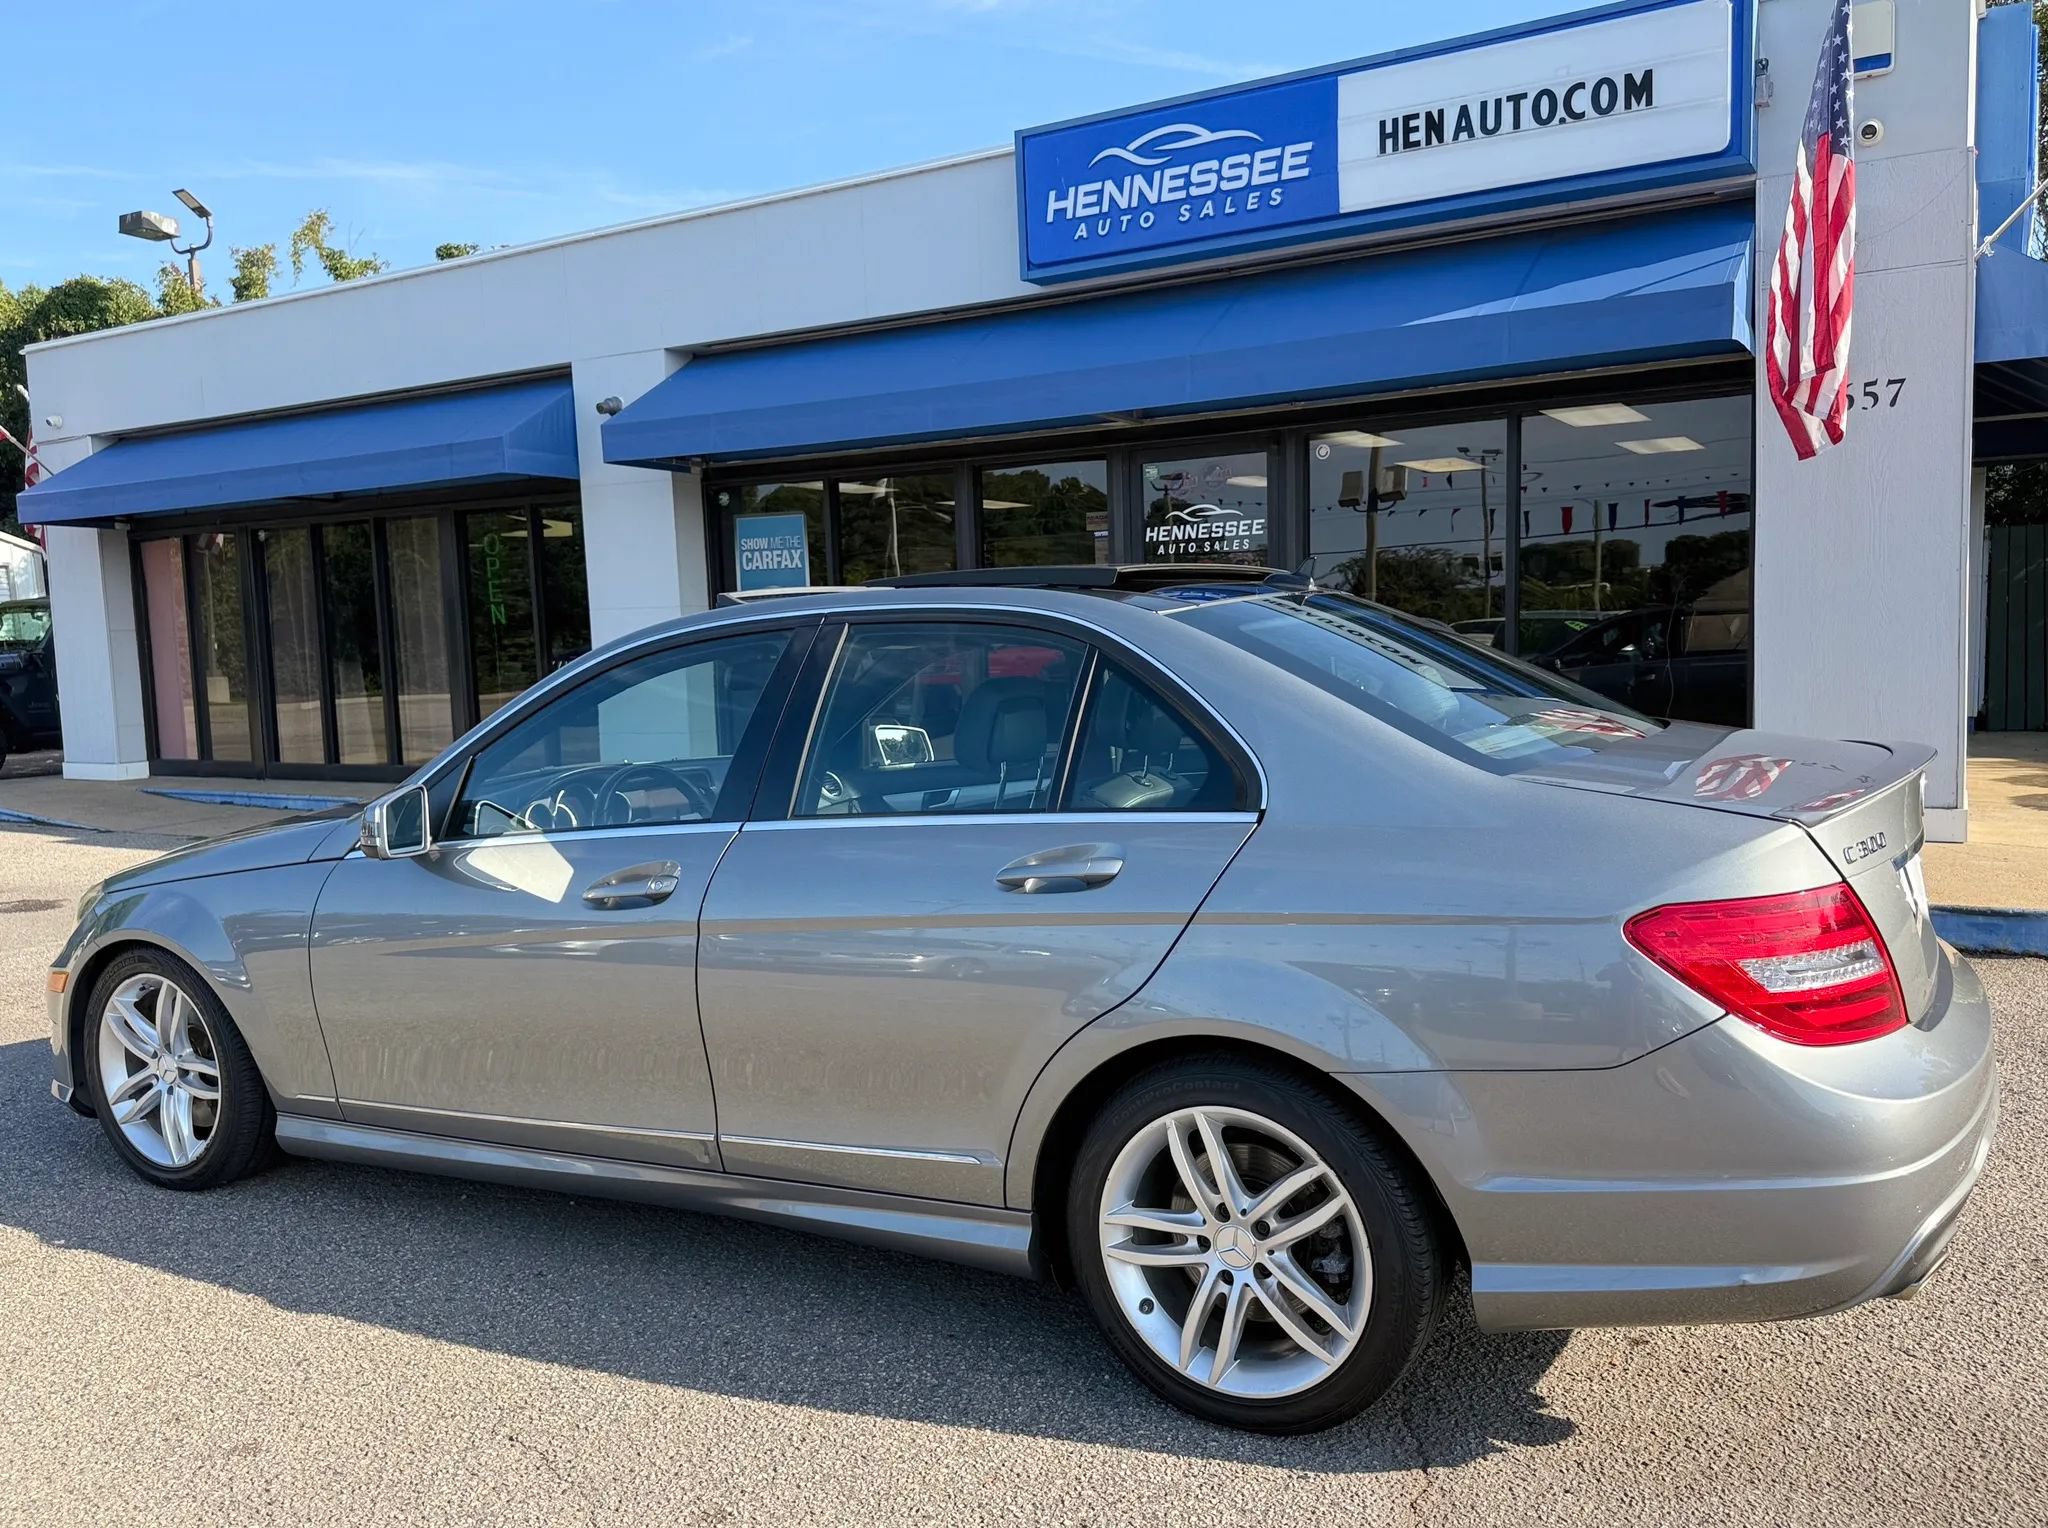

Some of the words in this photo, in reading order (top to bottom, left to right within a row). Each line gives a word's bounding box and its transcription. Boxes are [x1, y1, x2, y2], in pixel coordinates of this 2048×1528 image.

[1378, 68, 1654, 154] HENAUTO.COM
[1046, 141, 1313, 223] HENNESSEE
[1074, 210, 1155, 240] AUTO
[1178, 187, 1284, 222] SALES
[741, 537, 769, 550] SHOW
[770, 536, 784, 549] ME
[785, 535, 801, 548] THE
[1145, 519, 1265, 542] HENNESSEE
[1157, 542, 1196, 555] AUTO
[1203, 539, 1250, 552] SALES
[484, 533, 507, 625] OPEN
[742, 549, 804, 571] CARFAX
